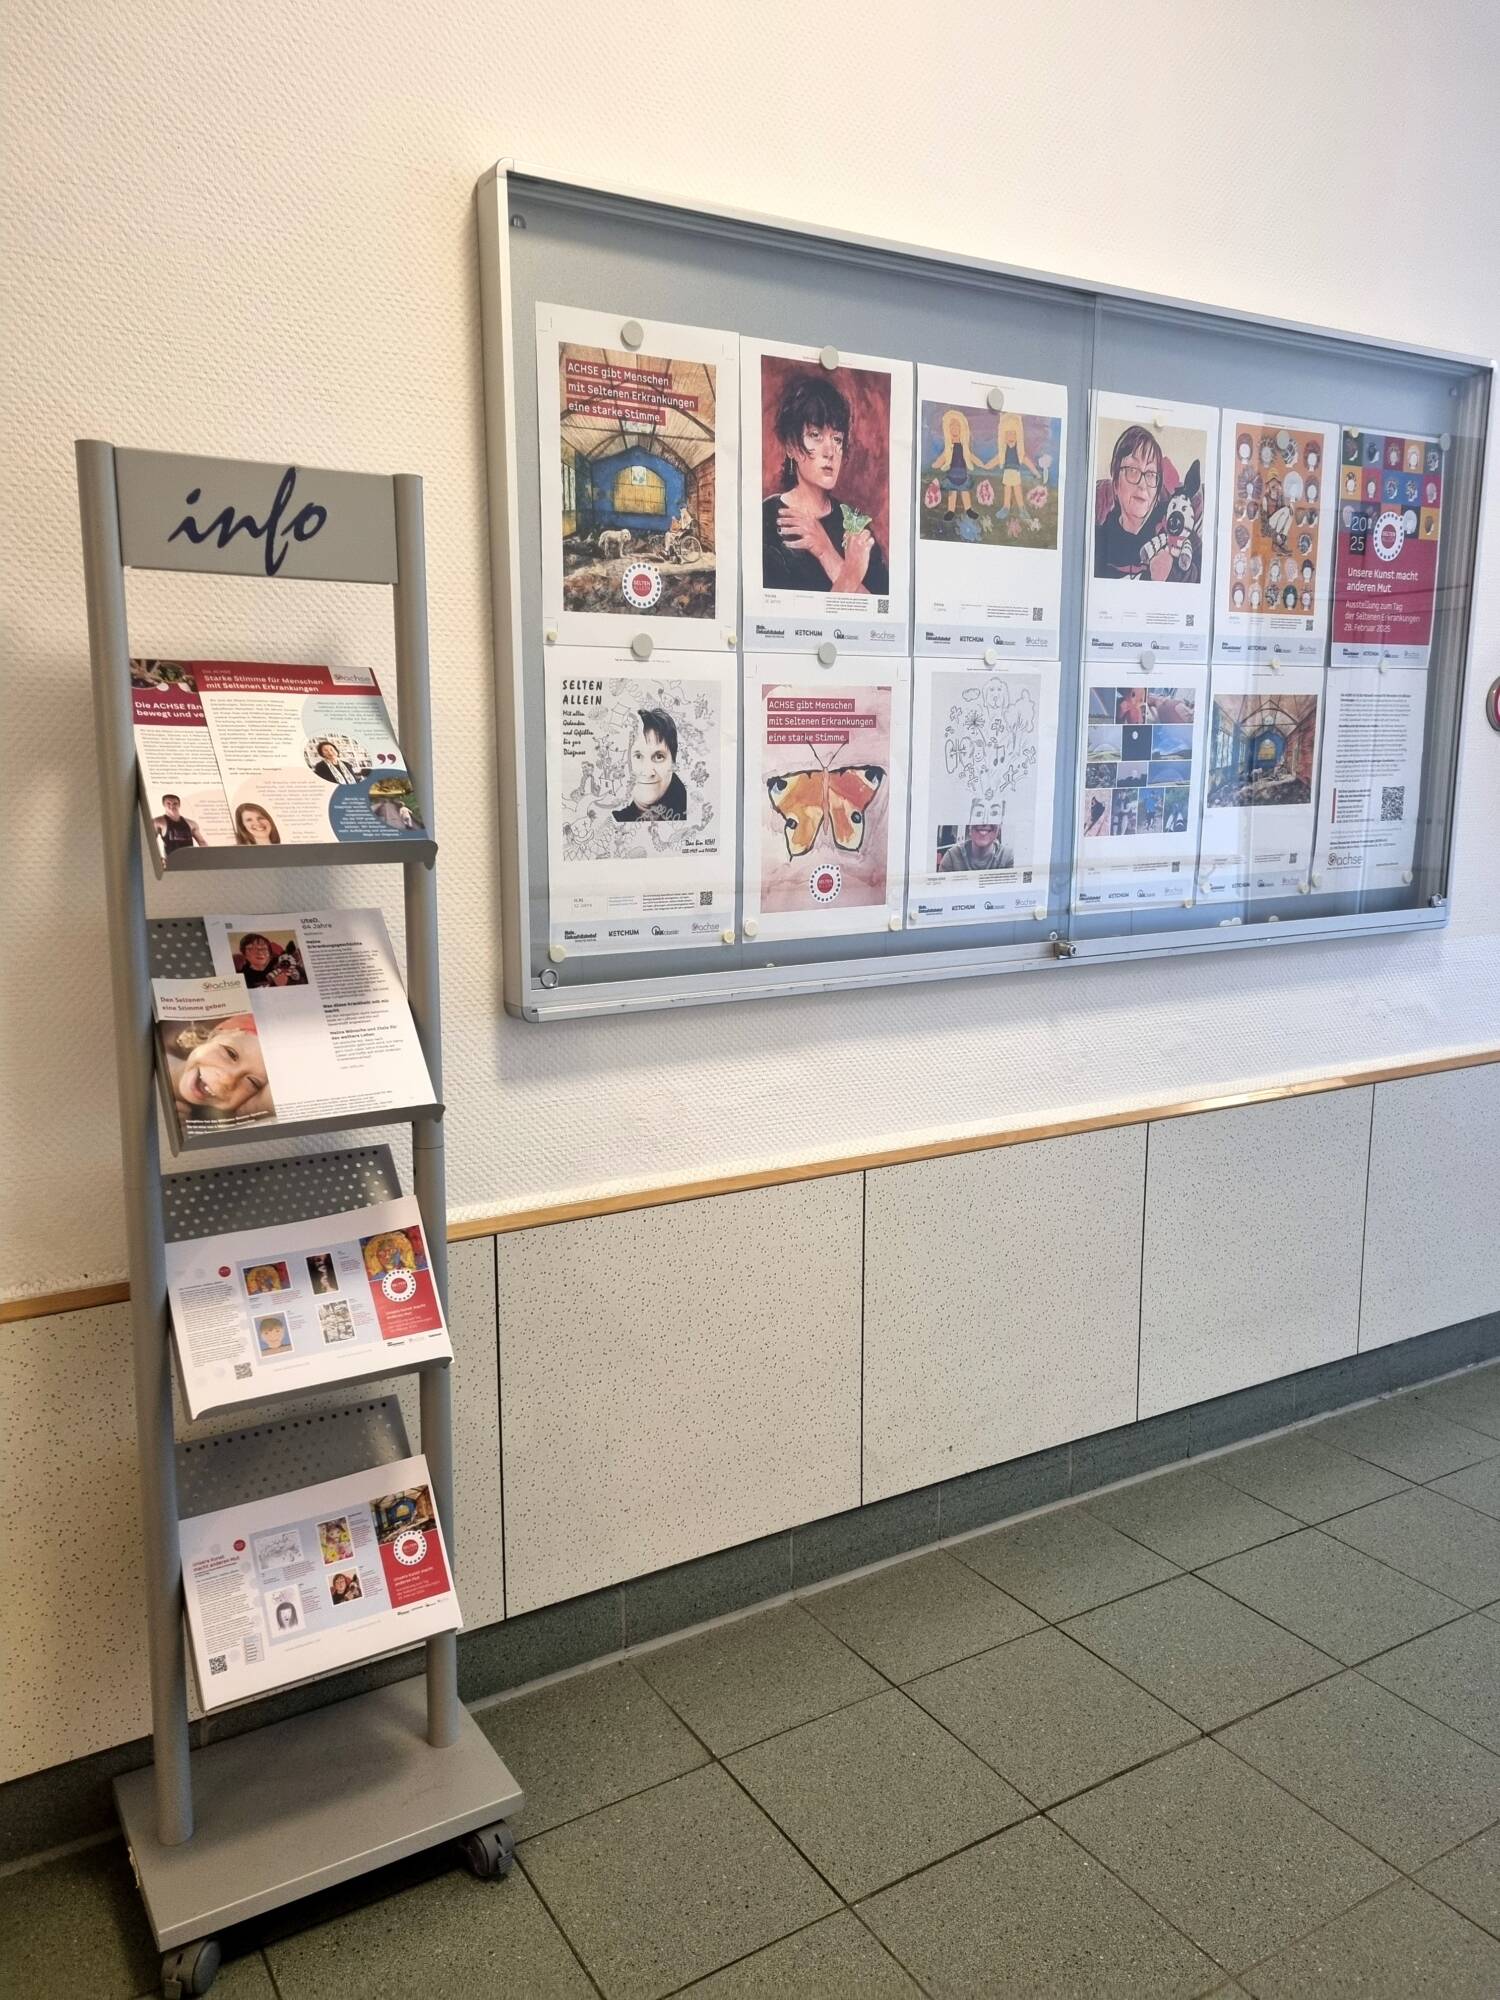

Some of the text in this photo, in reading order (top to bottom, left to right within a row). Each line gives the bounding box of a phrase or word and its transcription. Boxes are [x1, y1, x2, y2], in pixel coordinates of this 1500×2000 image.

[567, 362, 669, 386] ACHSE gibt Menschen
[568, 383, 695, 408] mit Seltenen Erkrankungen
[568, 402, 662, 422] eine starke Stimme.
[167, 466, 327, 576] info
[1352, 516, 1367, 531] 20
[1350, 536, 1365, 551] 25
[1347, 568, 1418, 581] Unsere Kunst macht
[1347, 581, 1392, 593] anderen Mut
[1345, 600, 1380, 611] Ausstellung
[1393, 602, 1403, 612] Tag
[1356, 612, 1380, 620] Seltenen
[1381, 613, 1420, 624] Erkrankungen
[1354, 624, 1376, 632] Februar
[262, 684, 319, 693] Erkrankungen
[563, 679, 602, 690] SELTEN
[135, 701, 151, 709] Die
[563, 694, 602, 705] ALLEIN
[768, 701, 852, 710] ACHSE gibt Menschen
[136, 710, 171, 718] bewegt
[769, 717, 873, 727] mit Seltenen Erkrankungen
[788, 733, 813, 741] starke
[815, 733, 847, 741] Stimme.
[1336, 852, 1363, 866] achse
[608, 929, 639, 937] KETCHUM
[205, 1003, 226, 1011] geben
